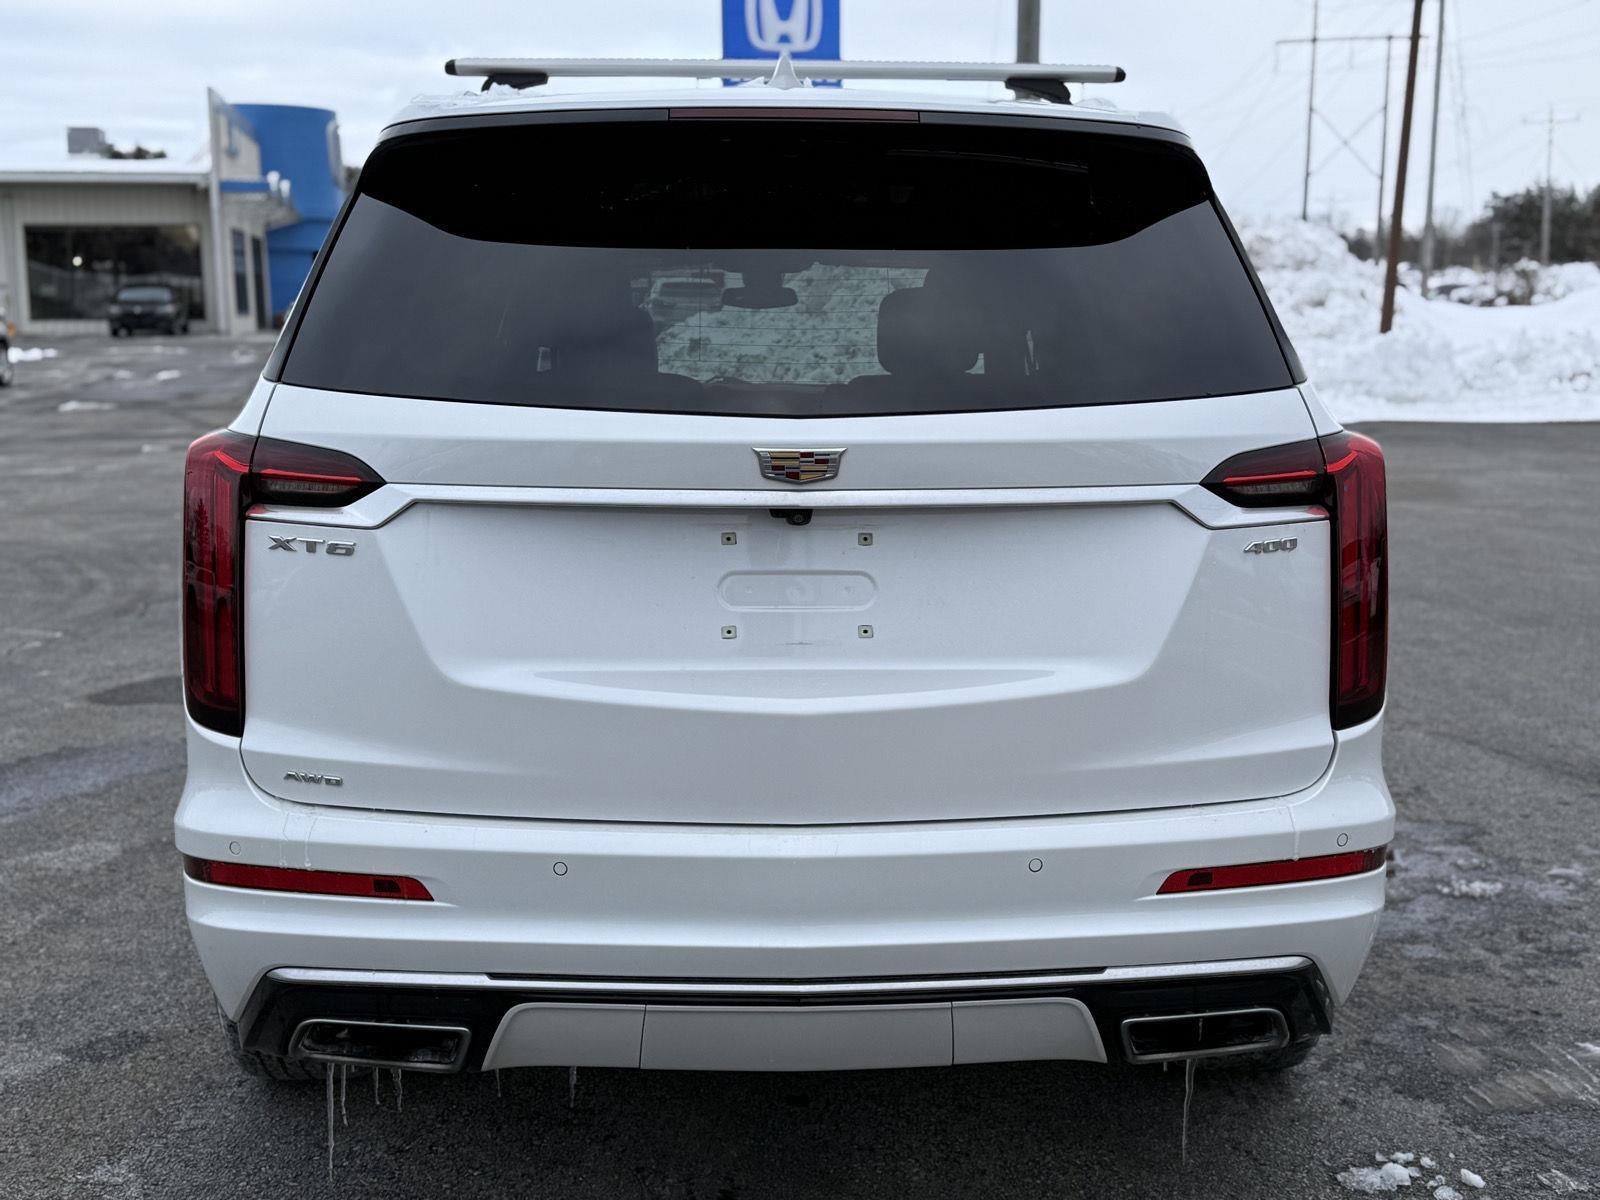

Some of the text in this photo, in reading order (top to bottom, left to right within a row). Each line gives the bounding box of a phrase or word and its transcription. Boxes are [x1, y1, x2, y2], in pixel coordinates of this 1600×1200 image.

[268, 535, 356, 556] XT6
[1243, 537, 1298, 554] 400
[283, 770, 343, 786] AWD
